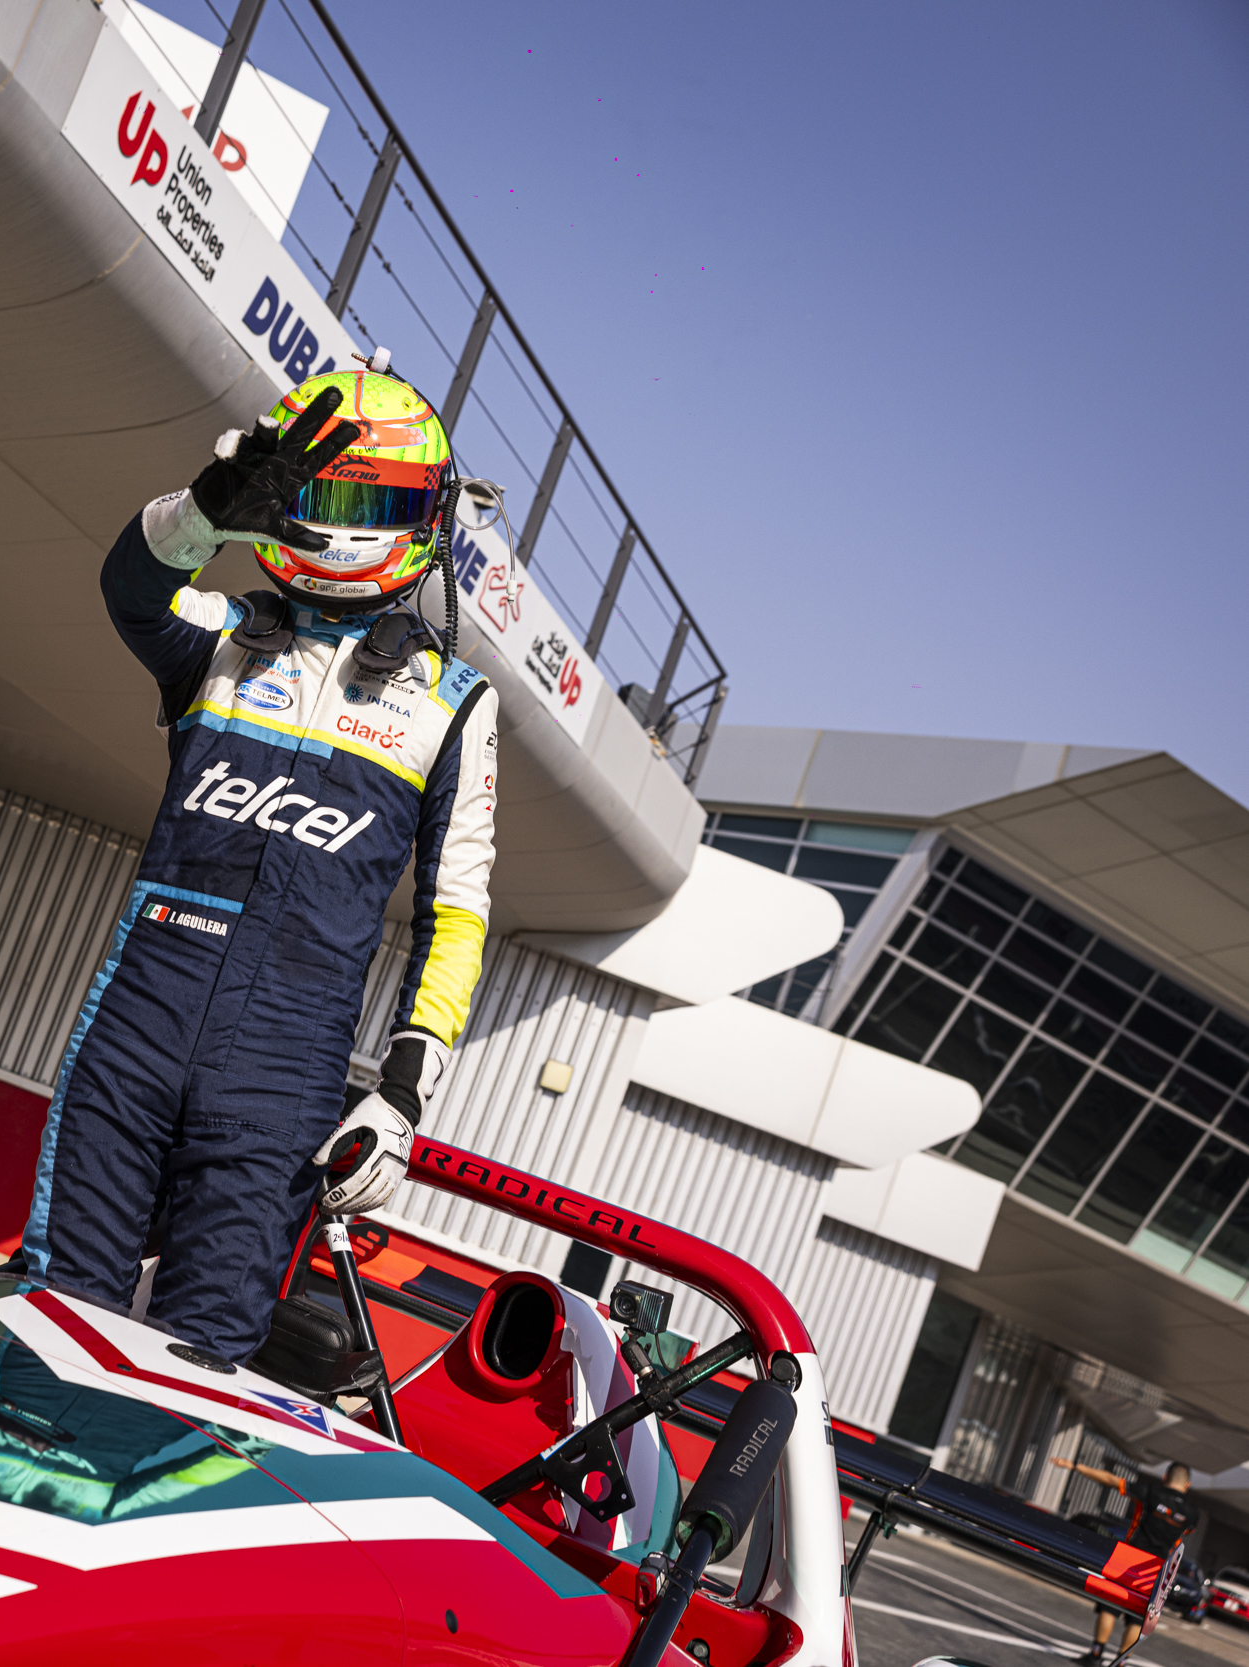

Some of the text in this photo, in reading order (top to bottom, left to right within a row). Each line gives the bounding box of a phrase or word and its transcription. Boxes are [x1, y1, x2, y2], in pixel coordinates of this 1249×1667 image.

[118, 90, 168, 186] UP
[177, 145, 212, 206] Union
[164, 172, 224, 260] Properties
[337, 469, 381, 482] RAW
[320, 585, 366, 594] gpp global
[252, 688, 287, 704] TELMEX
[367, 694, 411, 718] INTELA
[559, 654, 582, 710] UP
[337, 715, 395, 749] Claro
[183, 760, 377, 854] telcel
[176, 913, 228, 937] AGUILERA
[419, 1146, 657, 1249] RADICAL
[729, 1418, 778, 1477] RADICAL
